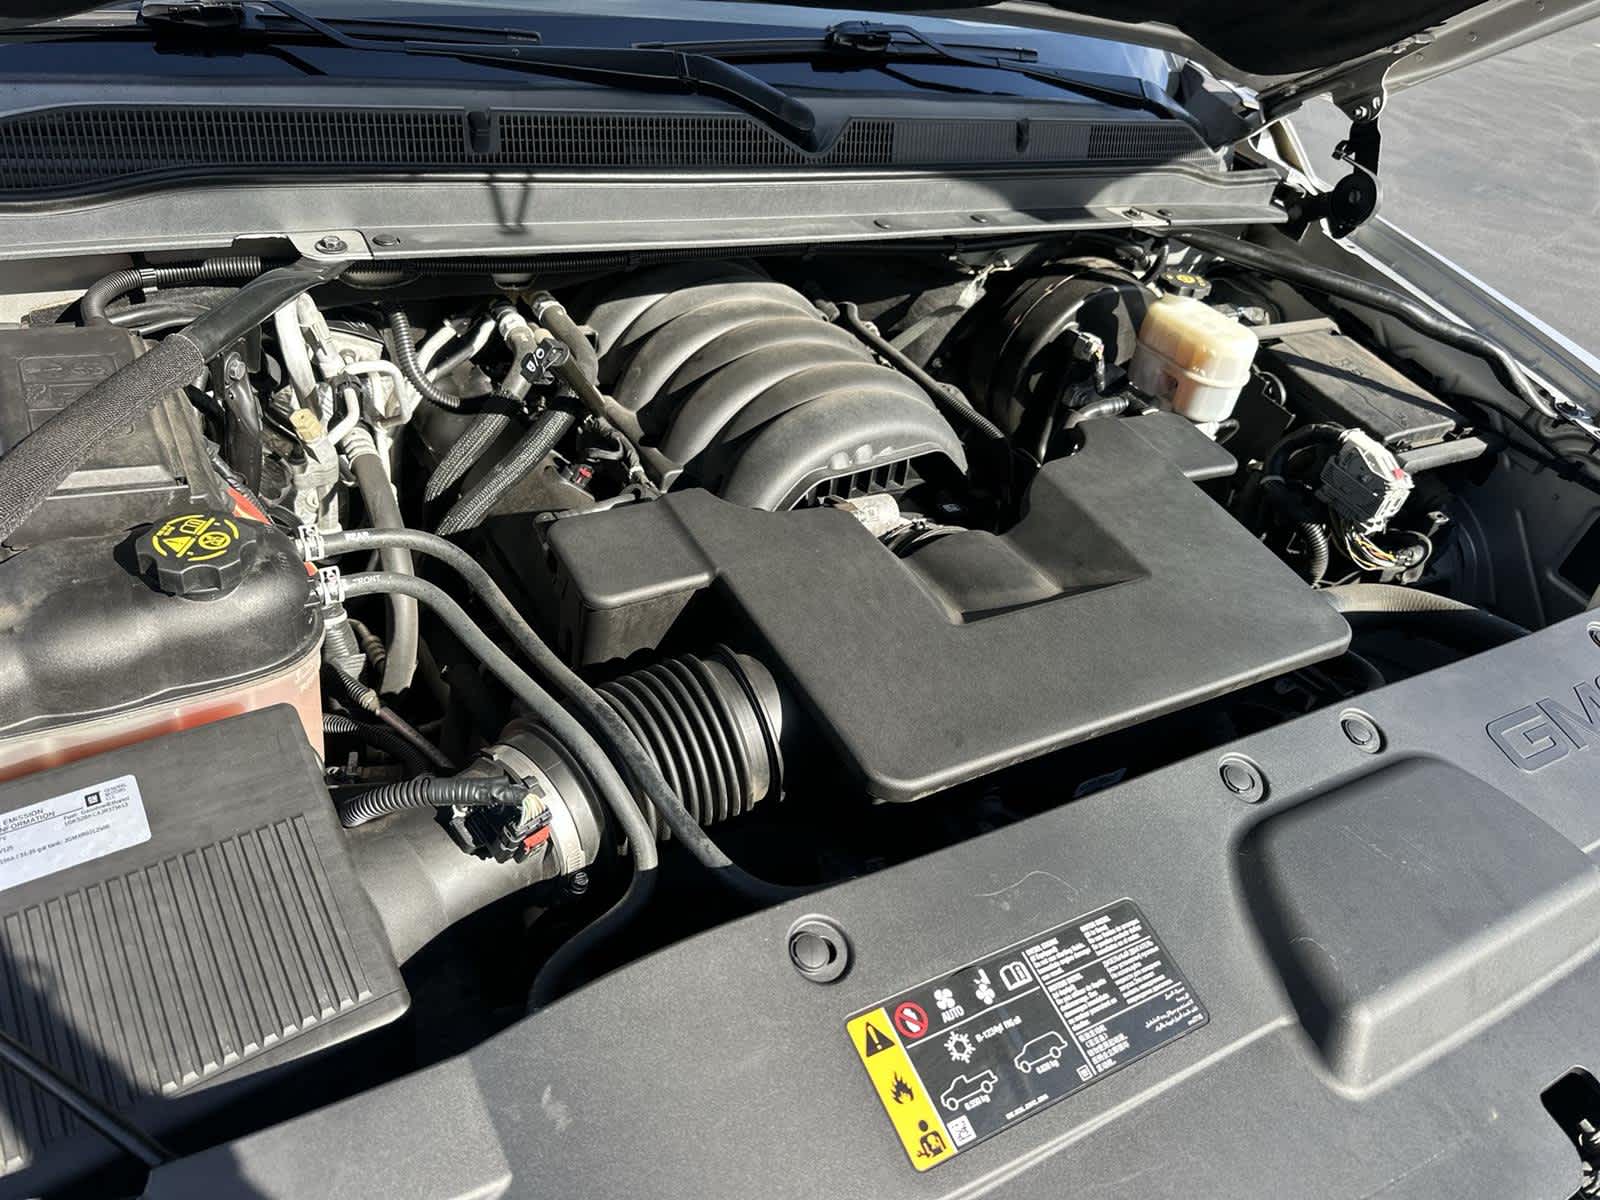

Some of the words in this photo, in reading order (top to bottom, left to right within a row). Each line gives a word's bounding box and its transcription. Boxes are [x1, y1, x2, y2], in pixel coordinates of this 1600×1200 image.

[1485, 674, 1600, 774] GM
[2, 808, 44, 826] EMISSION
[941, 1005, 965, 1024] AUTO
